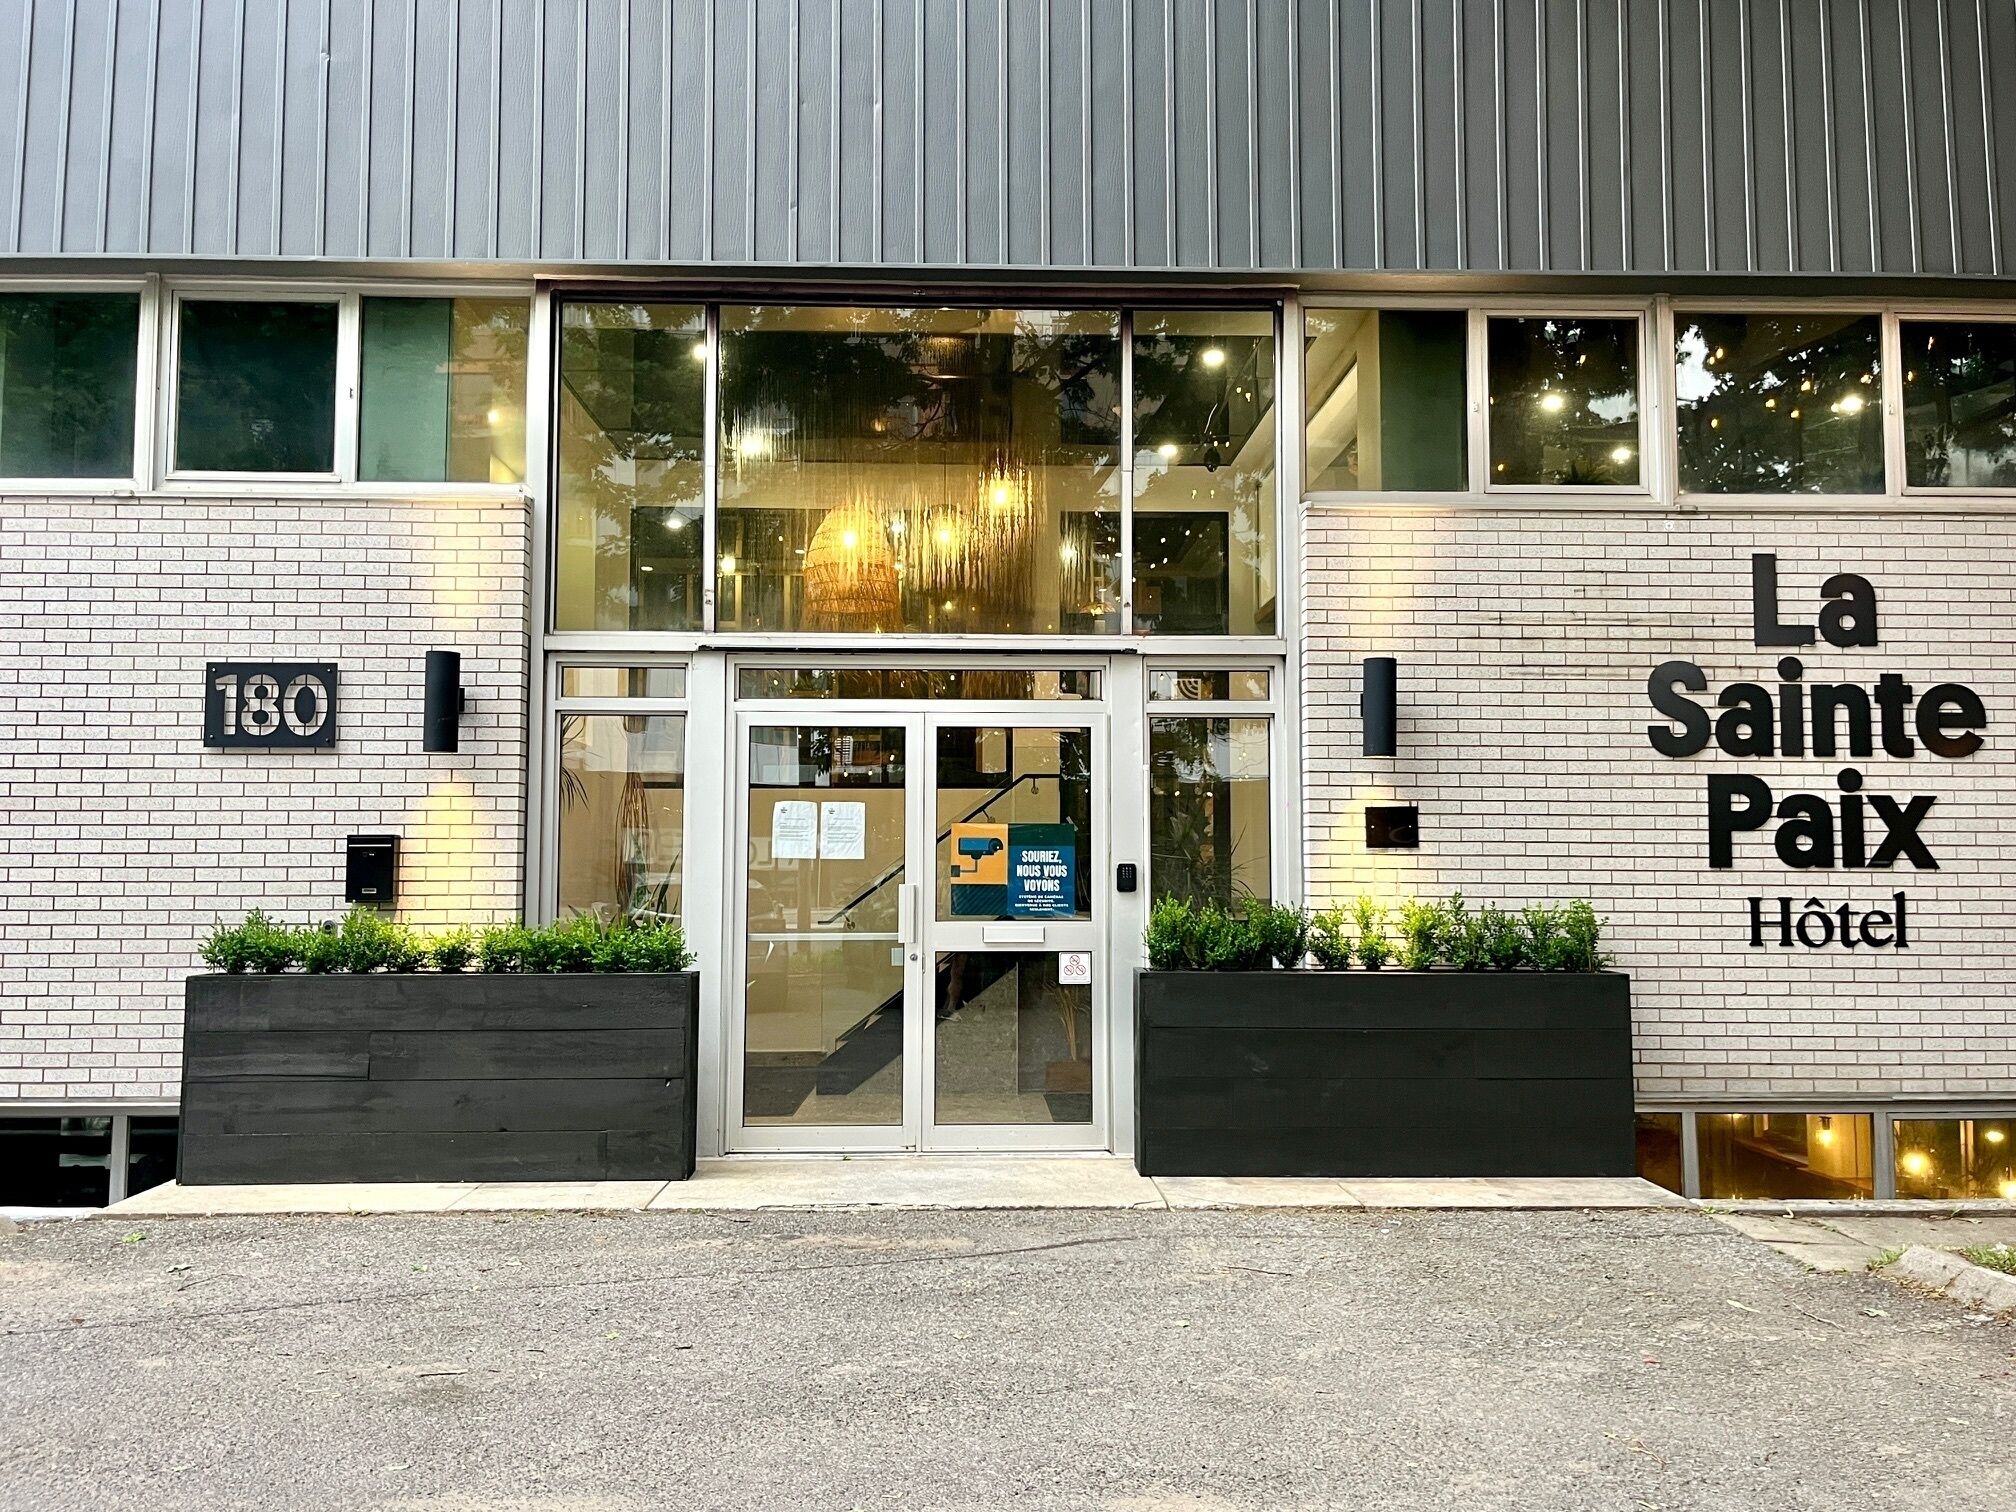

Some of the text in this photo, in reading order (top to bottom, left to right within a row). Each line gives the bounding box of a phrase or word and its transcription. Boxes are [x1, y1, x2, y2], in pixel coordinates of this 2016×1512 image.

[1751, 552, 1878, 647] La
[215, 674, 328, 736] 180
[1647, 656, 1987, 758] Sainte
[1707, 767, 1940, 869] Paix
[1016, 865, 1068, 877] NOUS VOUS
[1021, 850, 1062, 864] SOURIEZ,
[1024, 879, 1060, 892] VOYONS
[1747, 891, 1909, 948] Hôtel
